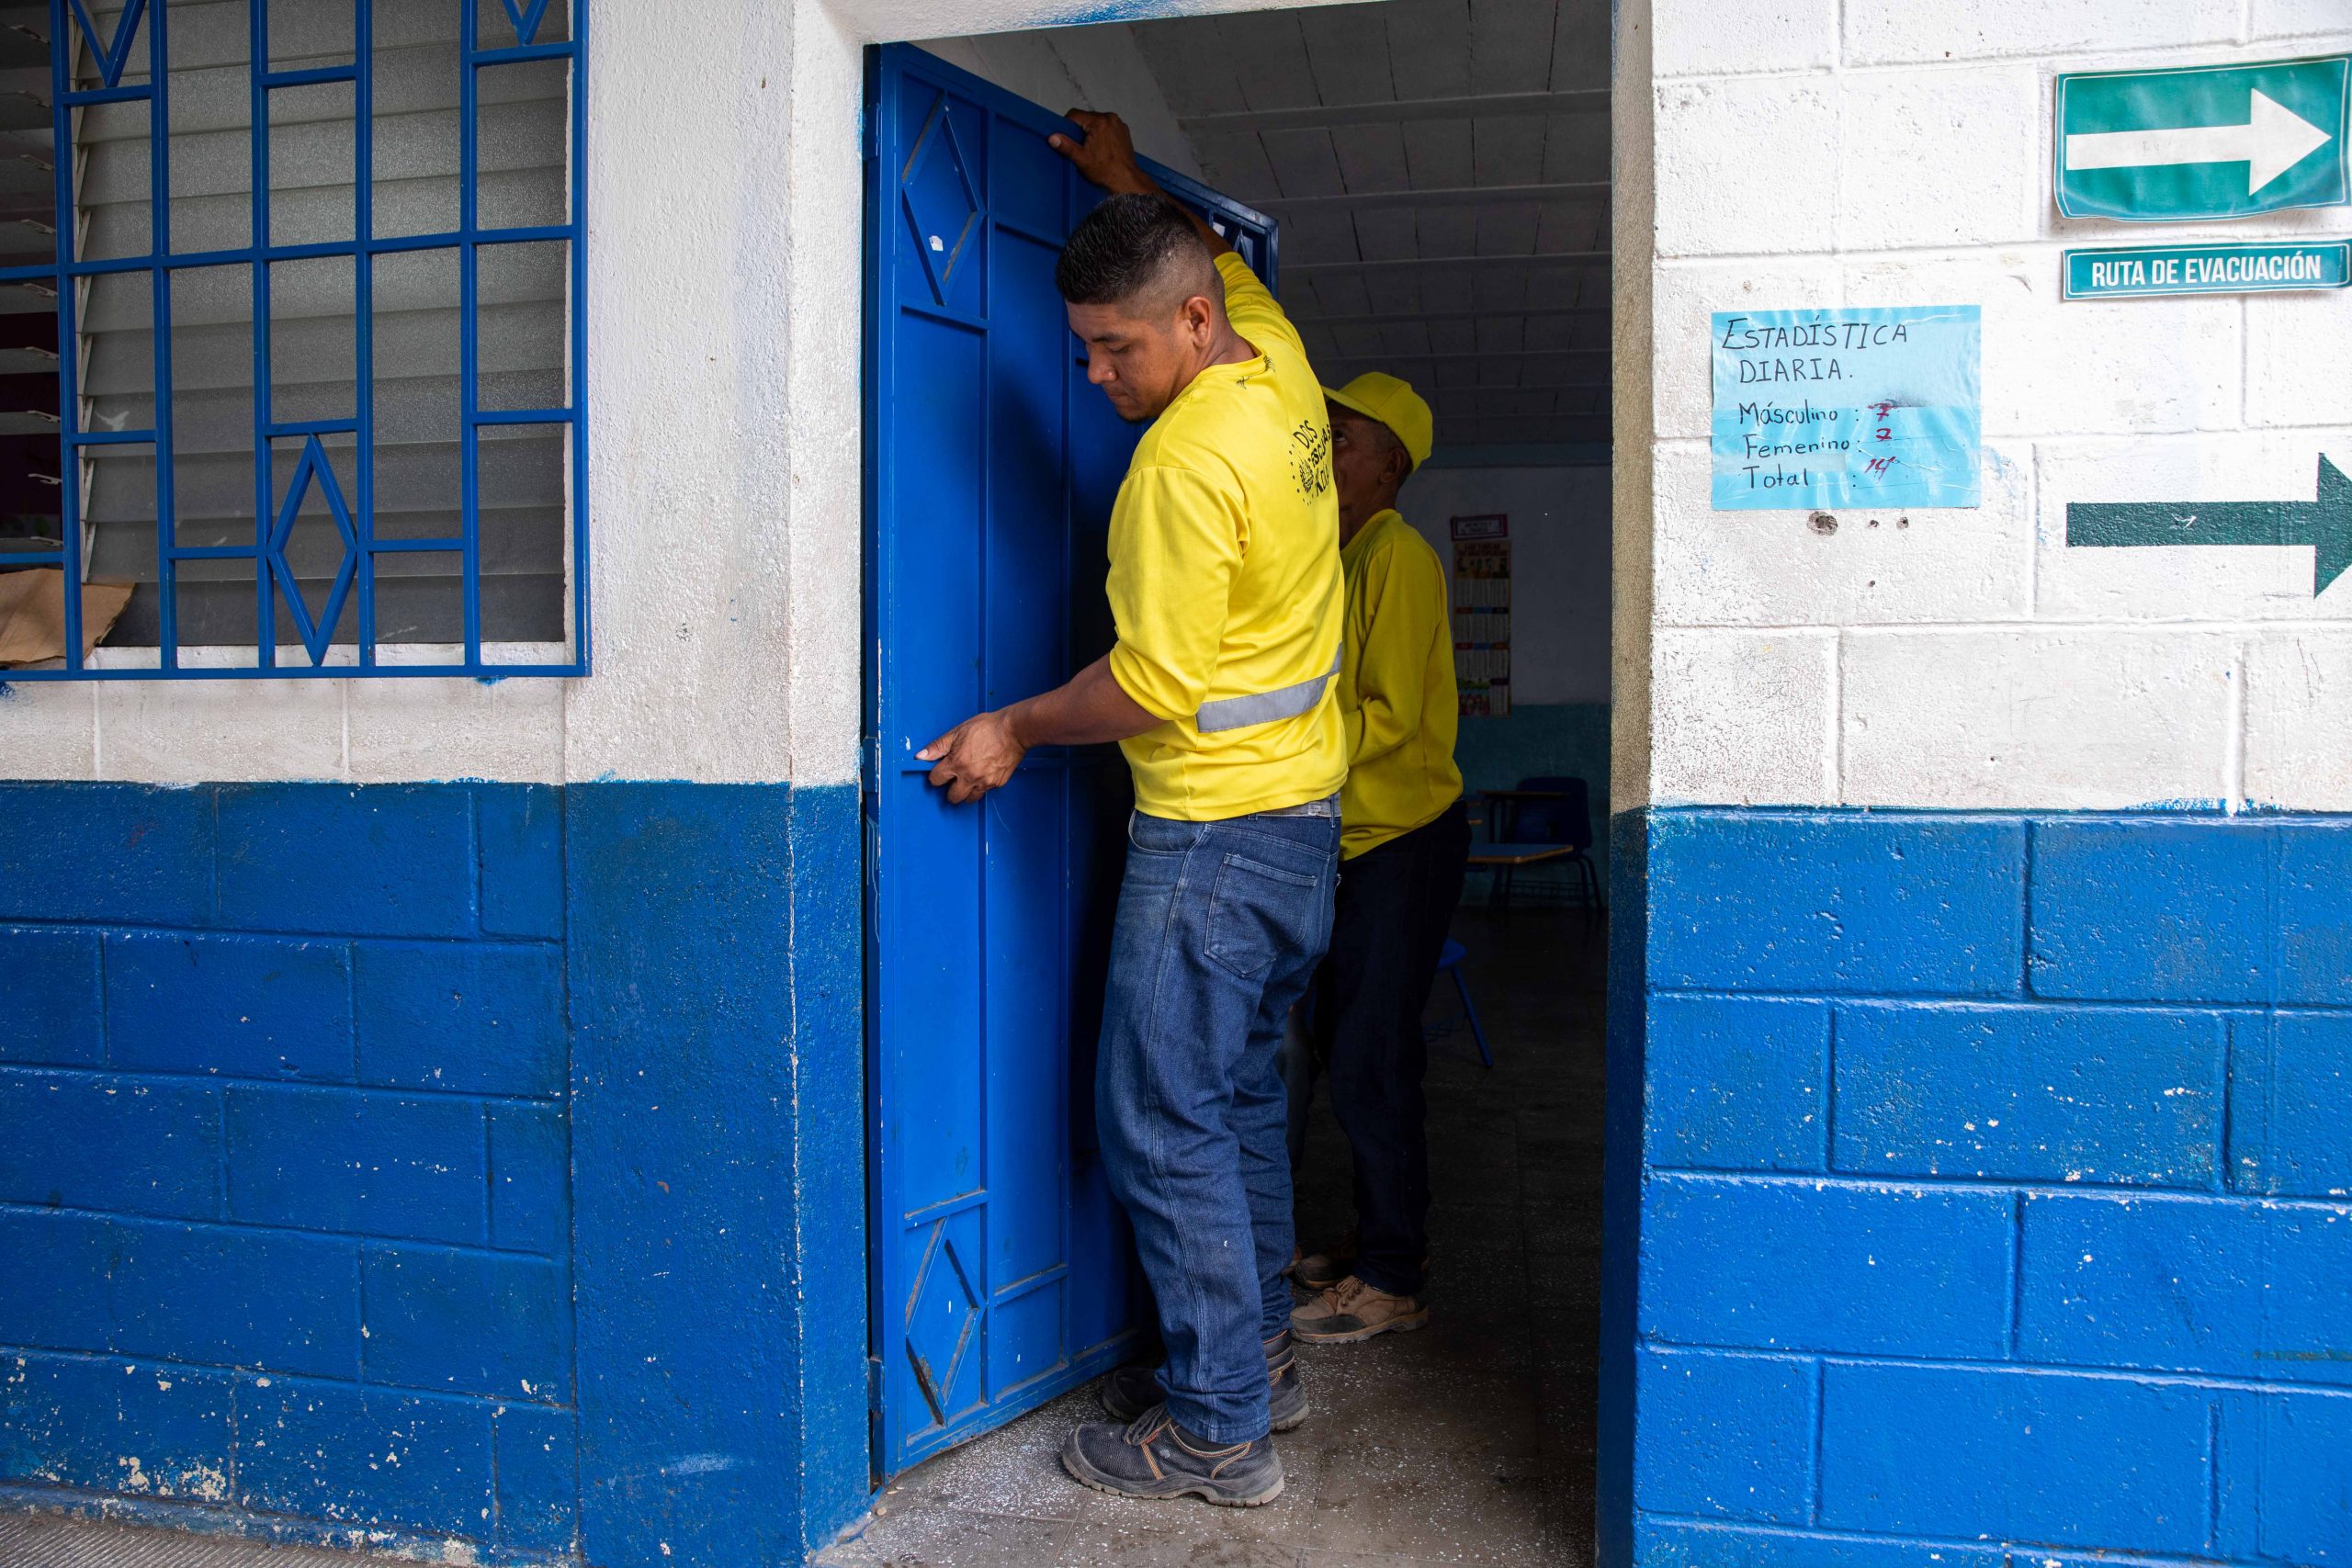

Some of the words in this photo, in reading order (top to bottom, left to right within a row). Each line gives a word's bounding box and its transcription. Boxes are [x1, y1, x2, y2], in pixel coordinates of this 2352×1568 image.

[2092, 260, 2146, 288] RUTA
[2151, 258, 2179, 285] DE
[2185, 251, 2321, 284] EVACUACIÓN
[1722, 314, 1908, 349] ESTADÍSTICA
[1742, 434, 1849, 459] Femenino
[1742, 463, 1810, 489] Total
